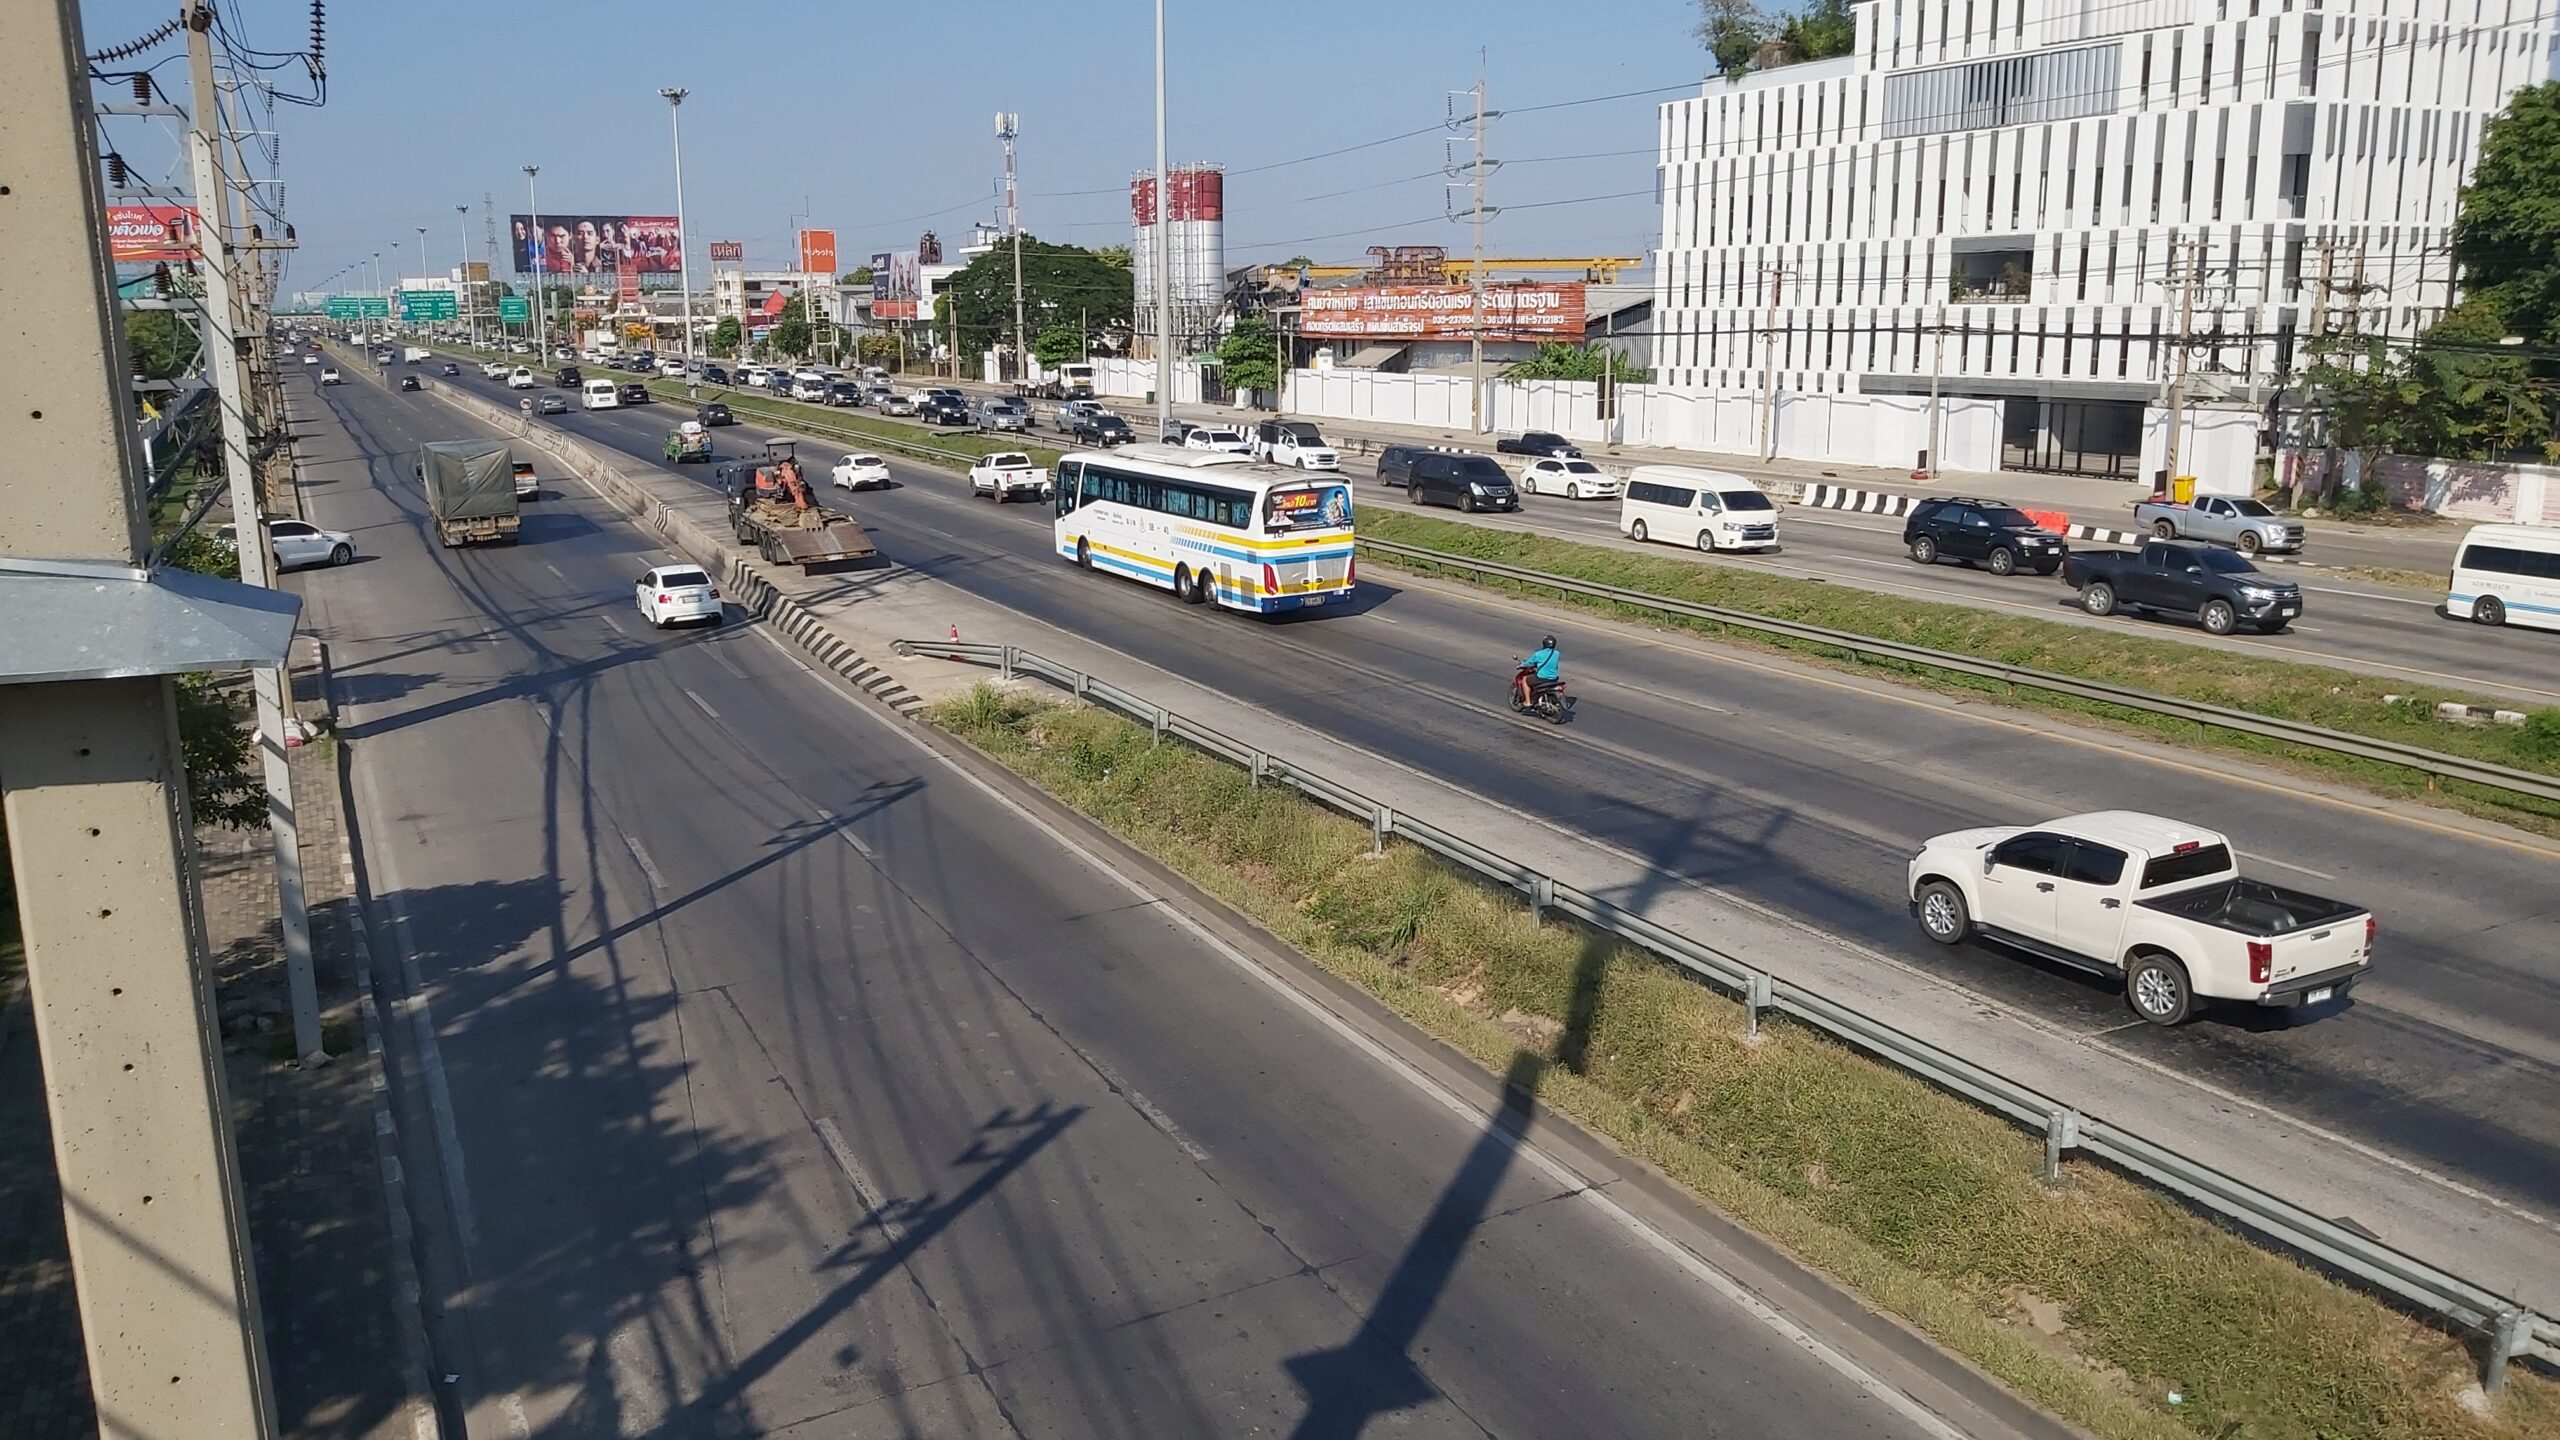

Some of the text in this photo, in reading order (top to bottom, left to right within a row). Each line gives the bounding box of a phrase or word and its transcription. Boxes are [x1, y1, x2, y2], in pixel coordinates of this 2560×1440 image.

[1307, 290, 1358, 316] ศูนย์จำหน่าย
[1481, 287, 1560, 313] ระดับมาตรฐาน
